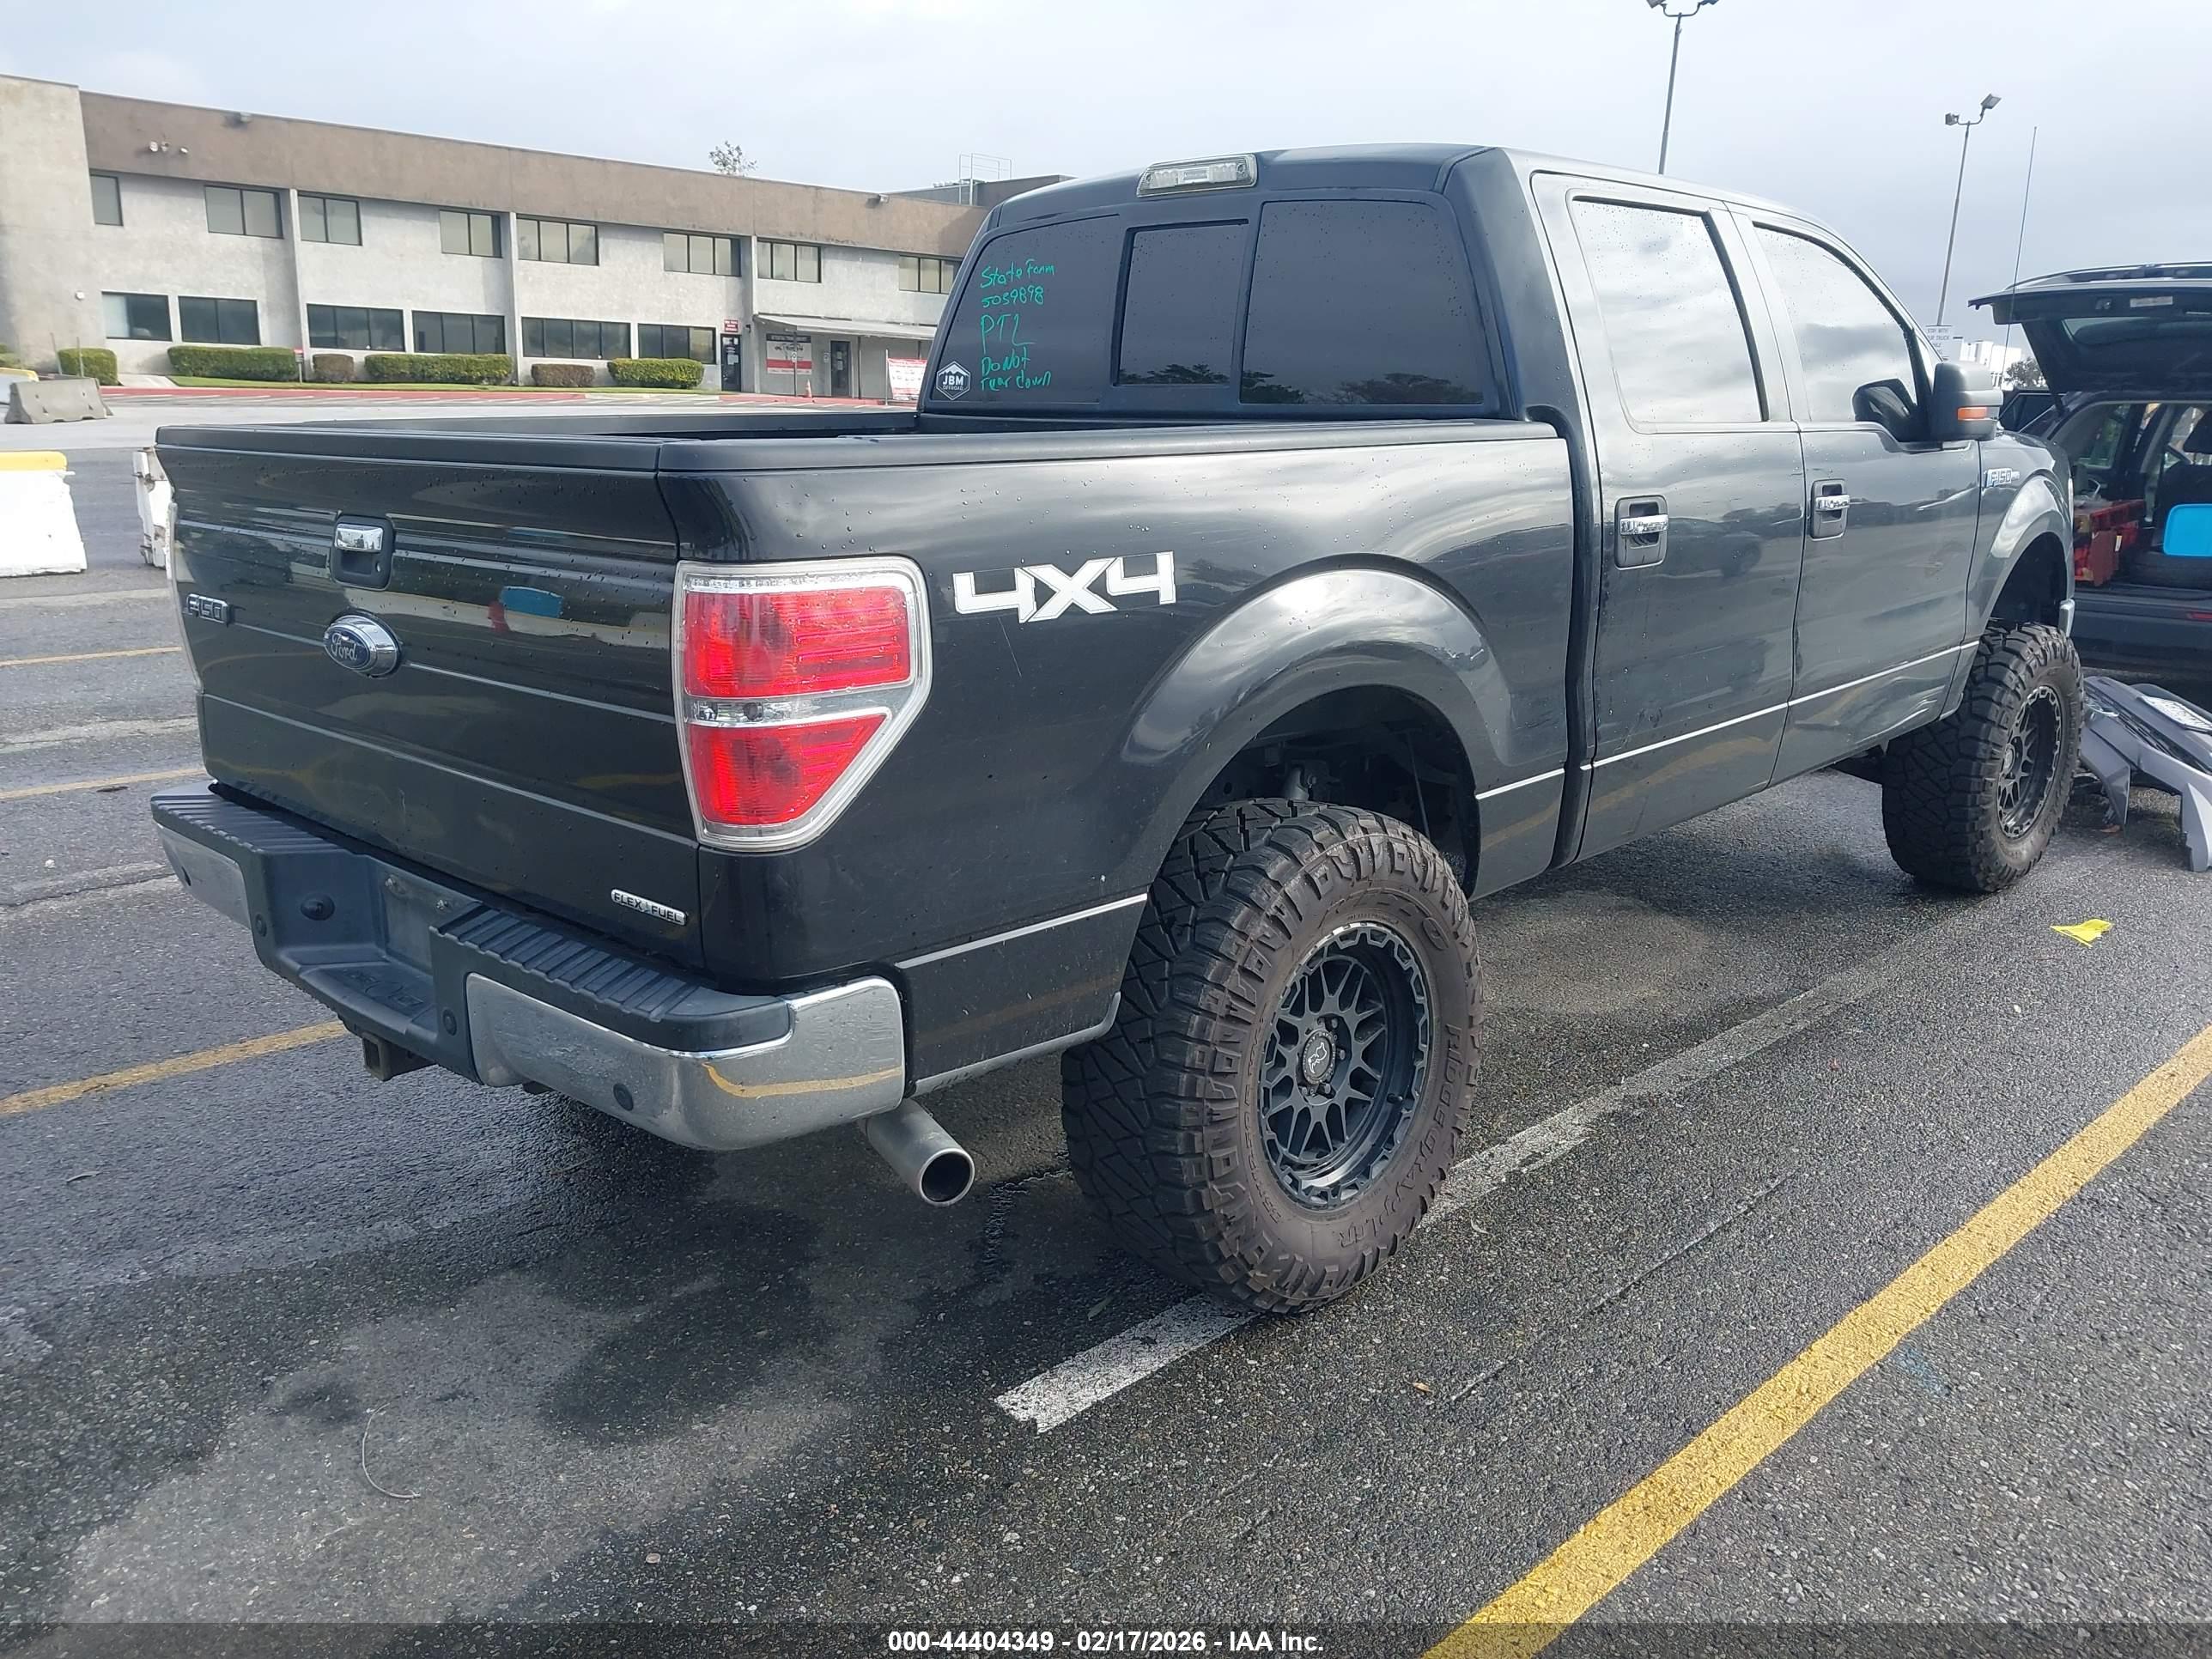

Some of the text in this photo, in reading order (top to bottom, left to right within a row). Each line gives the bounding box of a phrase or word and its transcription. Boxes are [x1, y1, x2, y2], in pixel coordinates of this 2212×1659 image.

[980, 261, 1023, 288] State
[942, 375, 964, 386] JBM
[1016, 370, 1051, 388] down
[952, 550, 1177, 624] 4X4
[331, 631, 359, 662] Ford
[613, 891, 684, 923] FLEX FUEL
